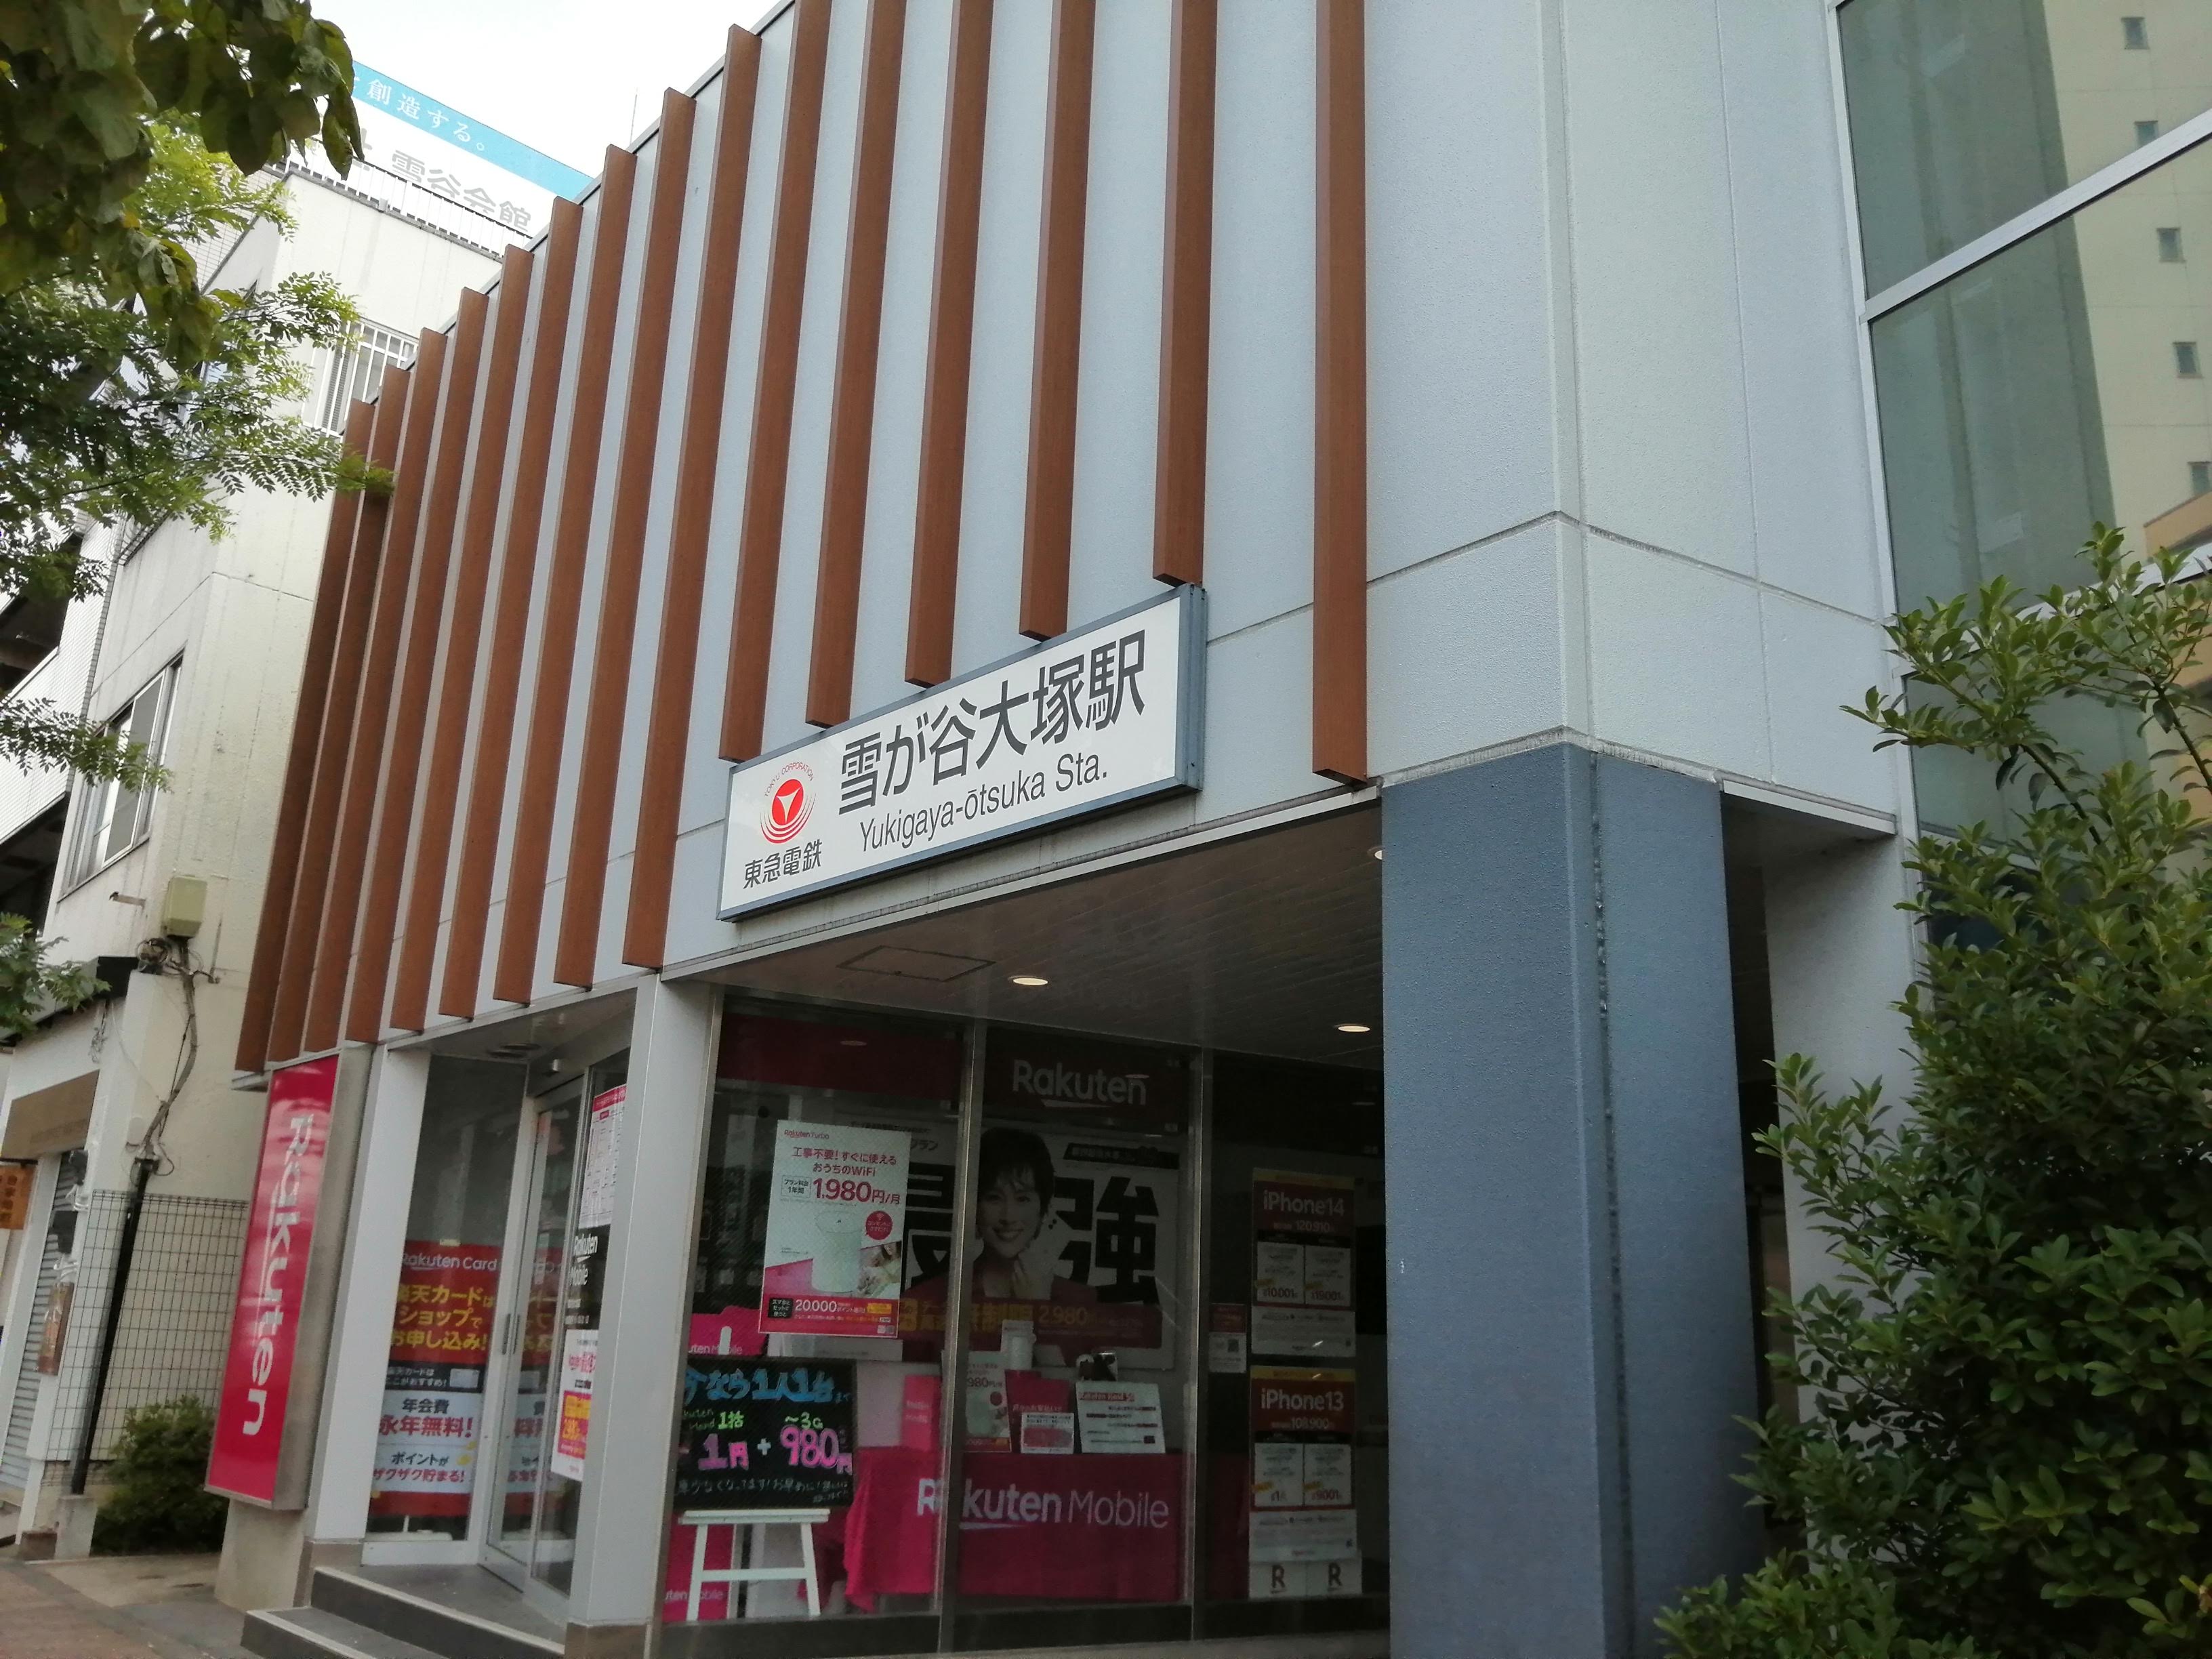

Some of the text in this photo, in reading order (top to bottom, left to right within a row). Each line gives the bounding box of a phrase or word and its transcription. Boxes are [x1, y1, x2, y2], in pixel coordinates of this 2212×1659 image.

[354, 76, 485, 151] 創造する。
[839, 630, 1145, 815] 雪が谷大塚駅
[764, 762, 814, 797] TOKYU CORPORATION
[1056, 751, 1107, 792] Sta.
[743, 839, 823, 889] 東急電鉄
[1012, 1059, 1147, 1107] Rakuten
[784, 1130, 810, 1138] Rakuten
[813, 1162, 876, 1177] おうちのWiFi
[243, 1113, 314, 1436] Rakuten
[463, 1257, 497, 1271] Card
[400, 1307, 483, 1328] ショップで
[403, 1399, 449, 1414] 年会費
[1261, 1388, 1344, 1410] iPhone13
[379, 1415, 473, 1438] 永年無料!
[392, 1452, 449, 1467] ポイントが
[917, 1478, 1169, 1530] Rkuten Mobile
